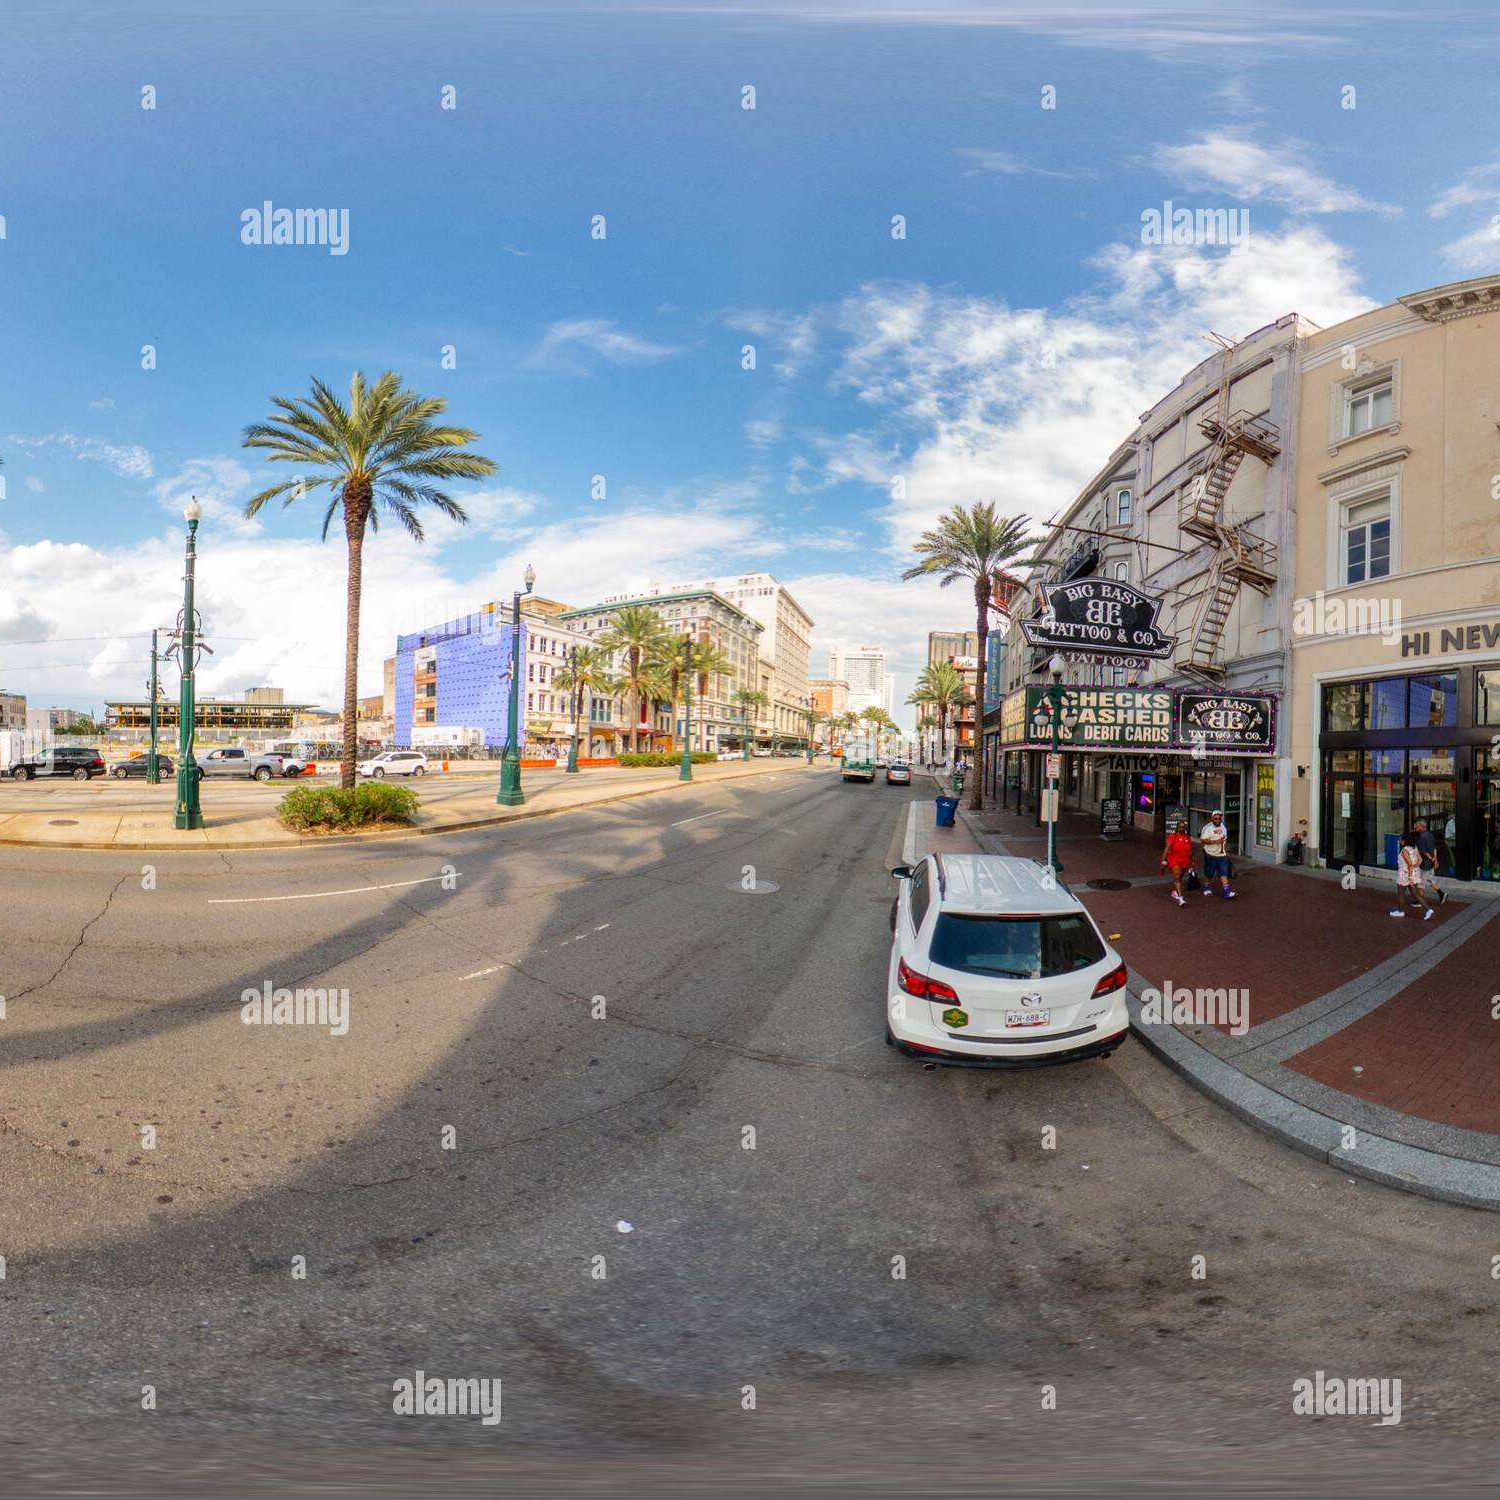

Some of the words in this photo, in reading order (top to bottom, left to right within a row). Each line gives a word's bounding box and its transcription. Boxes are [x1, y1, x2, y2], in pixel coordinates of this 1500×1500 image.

[1064, 584, 1095, 602] BIG
[1101, 584, 1143, 609] EASY
[1049, 621, 1111, 641] TATTOO
[1117, 628, 1128, 643] &
[1133, 630, 1157, 646] CO.
[1401, 631, 1430, 657] HI
[1066, 652, 1137, 668] TATTOO
[1060, 690, 1171, 709] CHECKS
[1194, 700, 1219, 712] BIG
[1223, 699, 1257, 714] EASY
[1060, 708, 1170, 726] CASHED
[1084, 725, 1121, 741] DEBIT
[1124, 726, 1170, 742] CARDS
[1188, 729, 1231, 739] TATTOO
[1234, 731, 1242, 739] &
[1245, 732, 1262, 740] CO.
[1108, 755, 1159, 771] TATTOO
